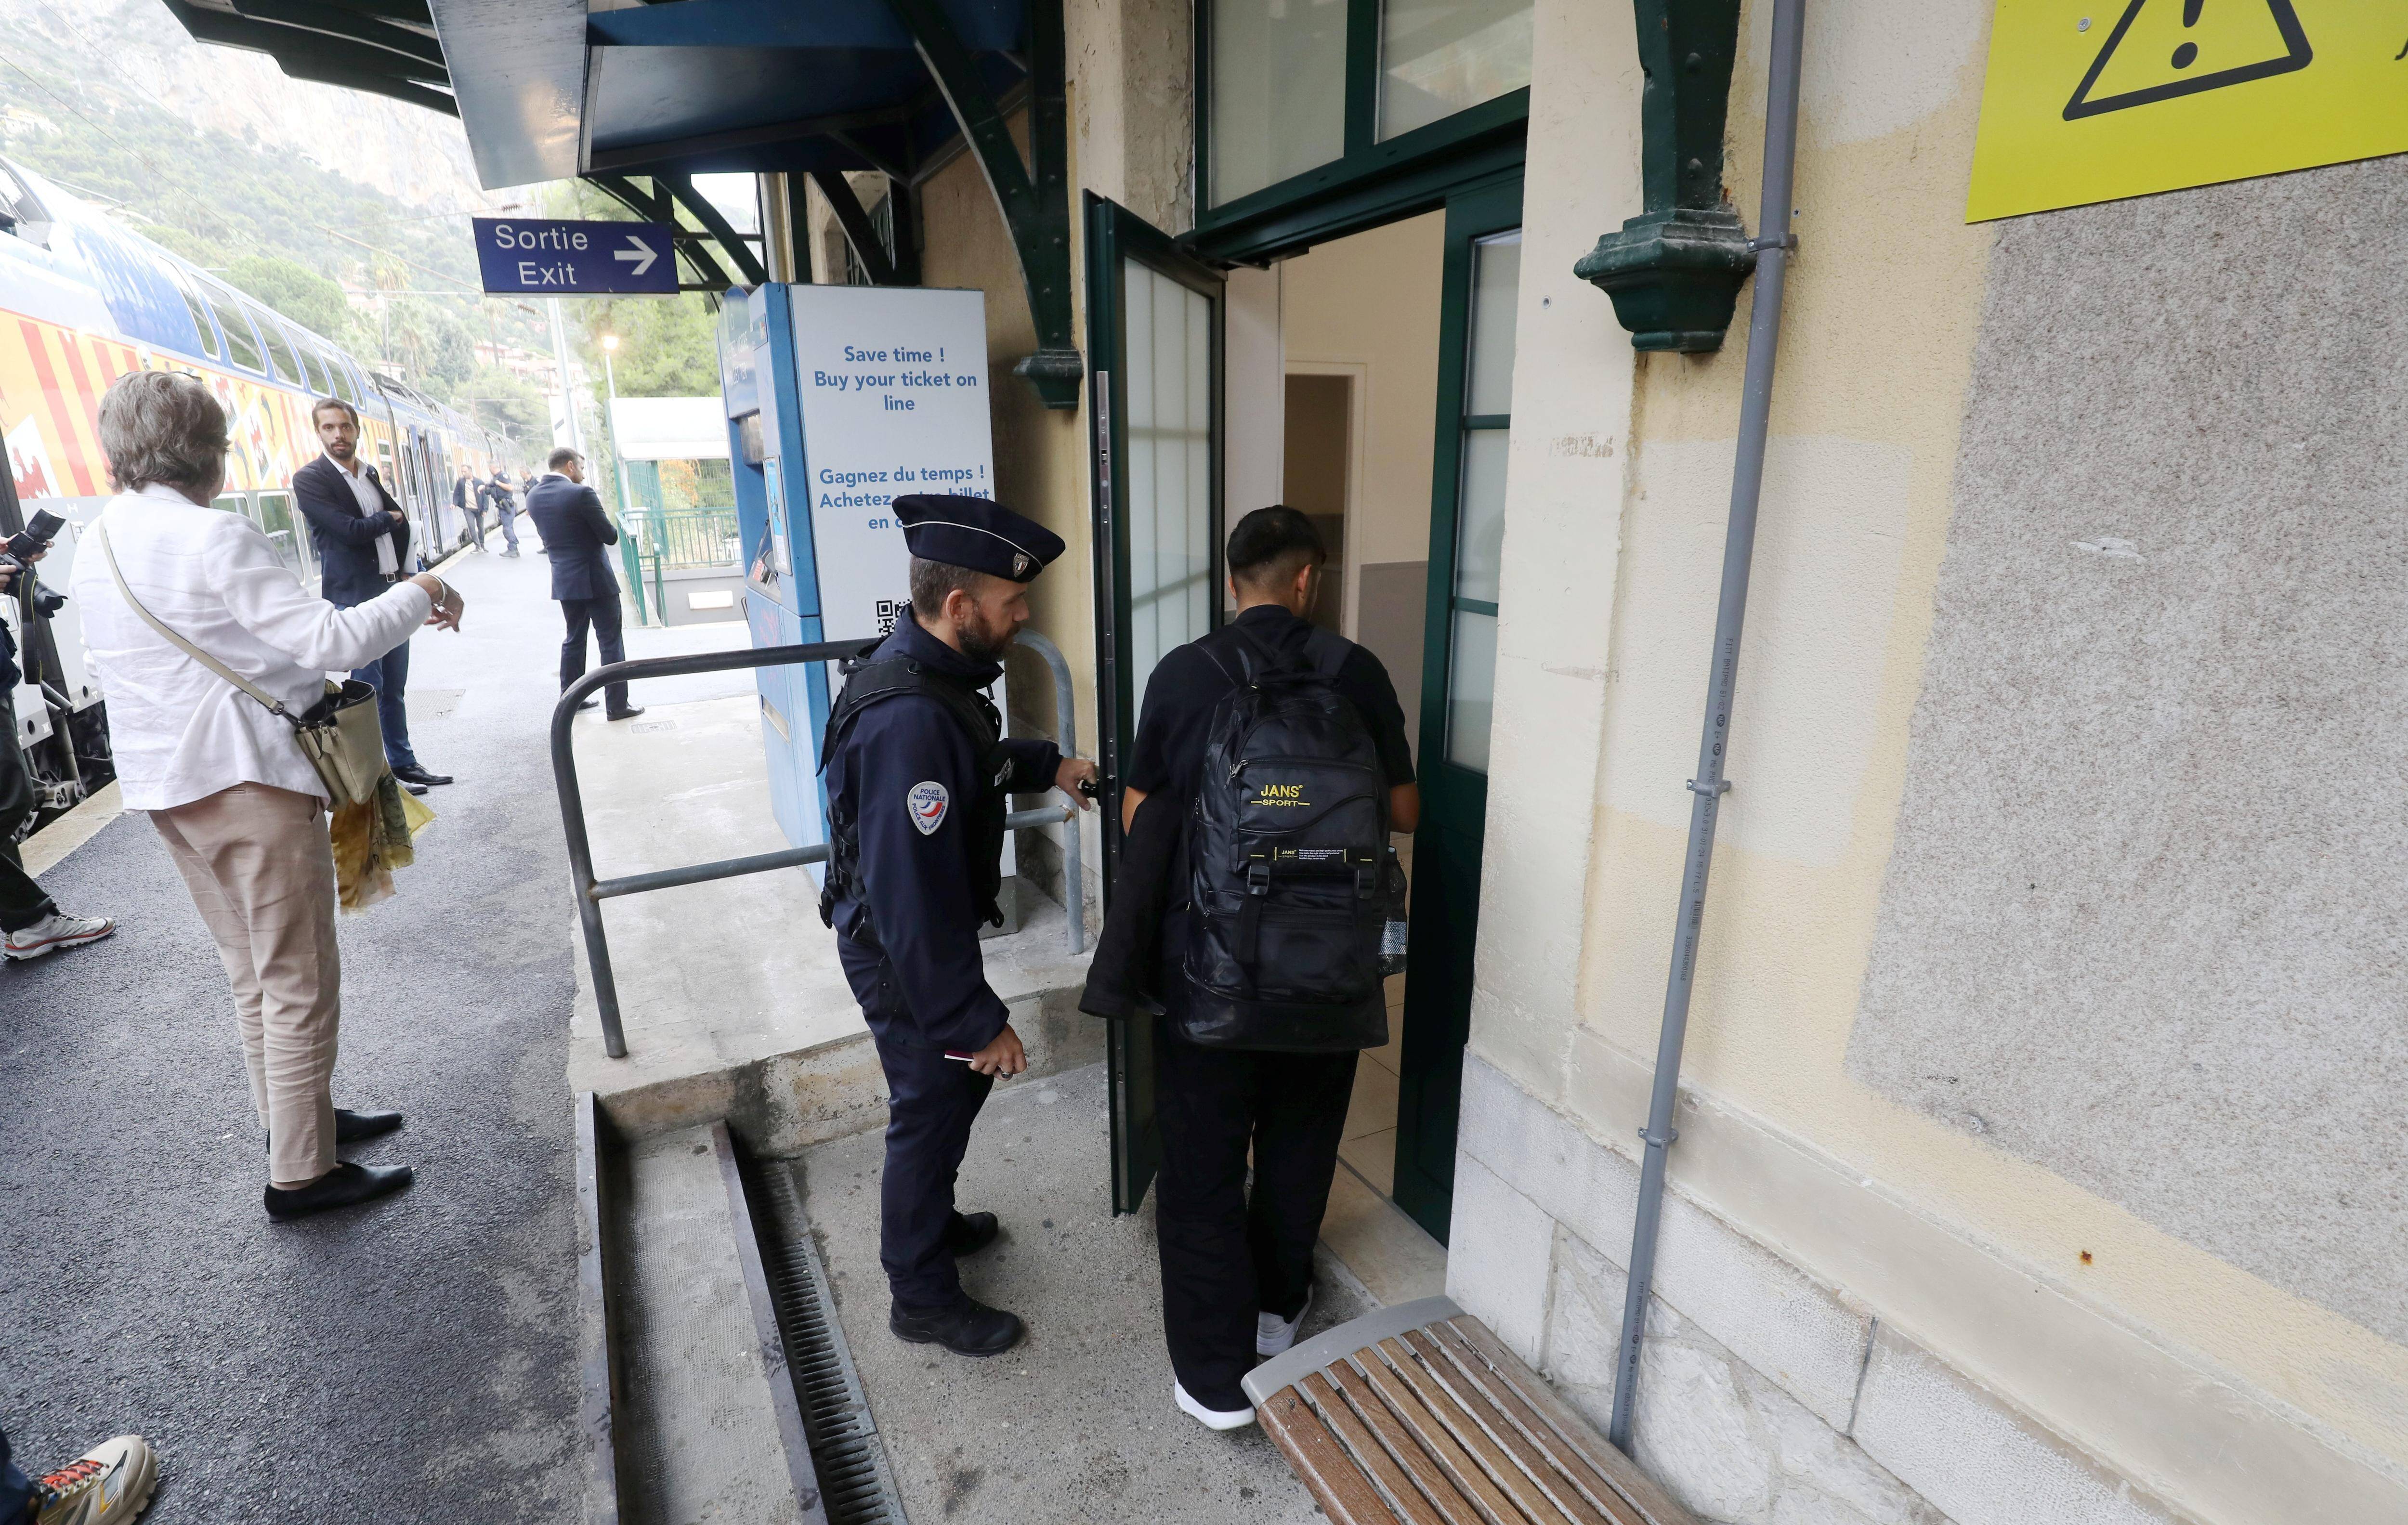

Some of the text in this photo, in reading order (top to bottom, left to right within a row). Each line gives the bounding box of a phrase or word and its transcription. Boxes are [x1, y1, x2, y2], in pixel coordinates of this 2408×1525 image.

[495, 224, 588, 250] Sortie
[518, 261, 577, 285] Exit
[844, 346, 944, 362] Save time !
[814, 370, 977, 391] Buy your ticket on
[884, 394, 915, 410] line
[819, 465, 984, 487] Gagnez du temps !
[820, 492, 891, 508] Achetez
[868, 518, 889, 529] en
[1262, 799, 1298, 807] SPORT
[912, 803, 921, 821] POLICE
[919, 821, 928, 830] AUX
